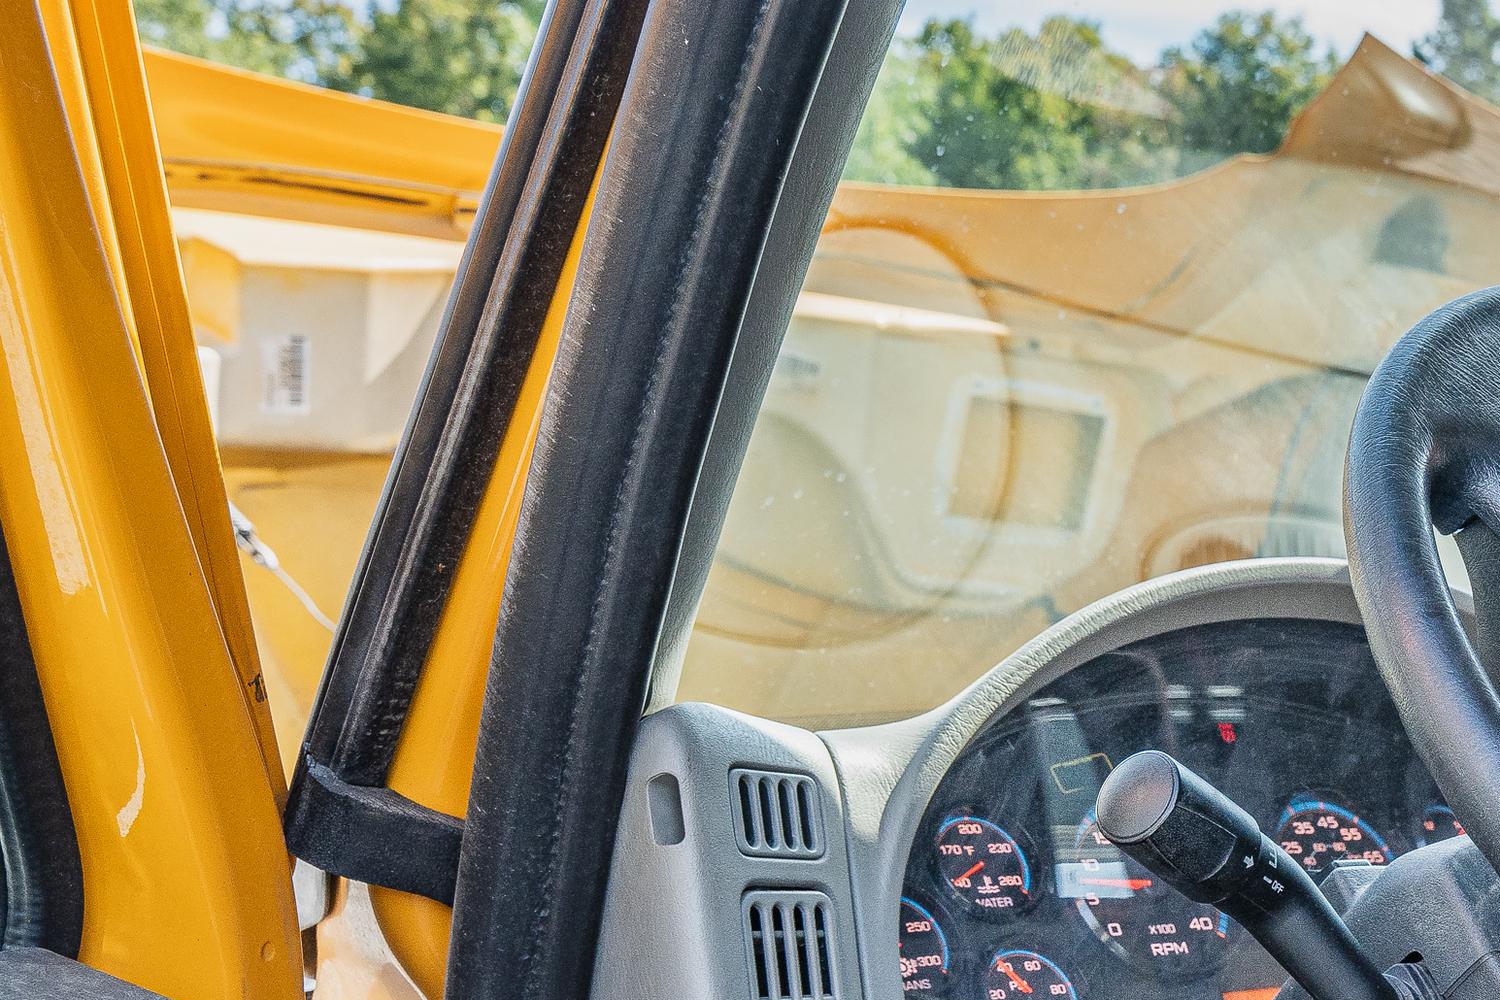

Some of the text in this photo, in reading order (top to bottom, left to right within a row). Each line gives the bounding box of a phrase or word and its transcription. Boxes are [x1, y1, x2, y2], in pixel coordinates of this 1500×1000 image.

[1292, 821, 1315, 835] 35
[1317, 816, 1339, 829] 45
[957, 823, 983, 835] 200
[1340, 827, 1362, 841] 55
[939, 844, 962, 855] 170
[987, 843, 1012, 854] 230
[998, 875, 1023, 886] 260
[1271, 880, 1285, 894] OFF
[1086, 892, 1100, 905] 5
[906, 921, 931, 933] 250
[1189, 916, 1213, 930] 40
[1107, 923, 1122, 936] 0
[1150, 942, 1189, 956] RPM
[918, 955, 942, 966] 300
[1024, 960, 1041, 971] 60
[989, 989, 1006, 1000] 20
[1050, 984, 1067, 995] 80
